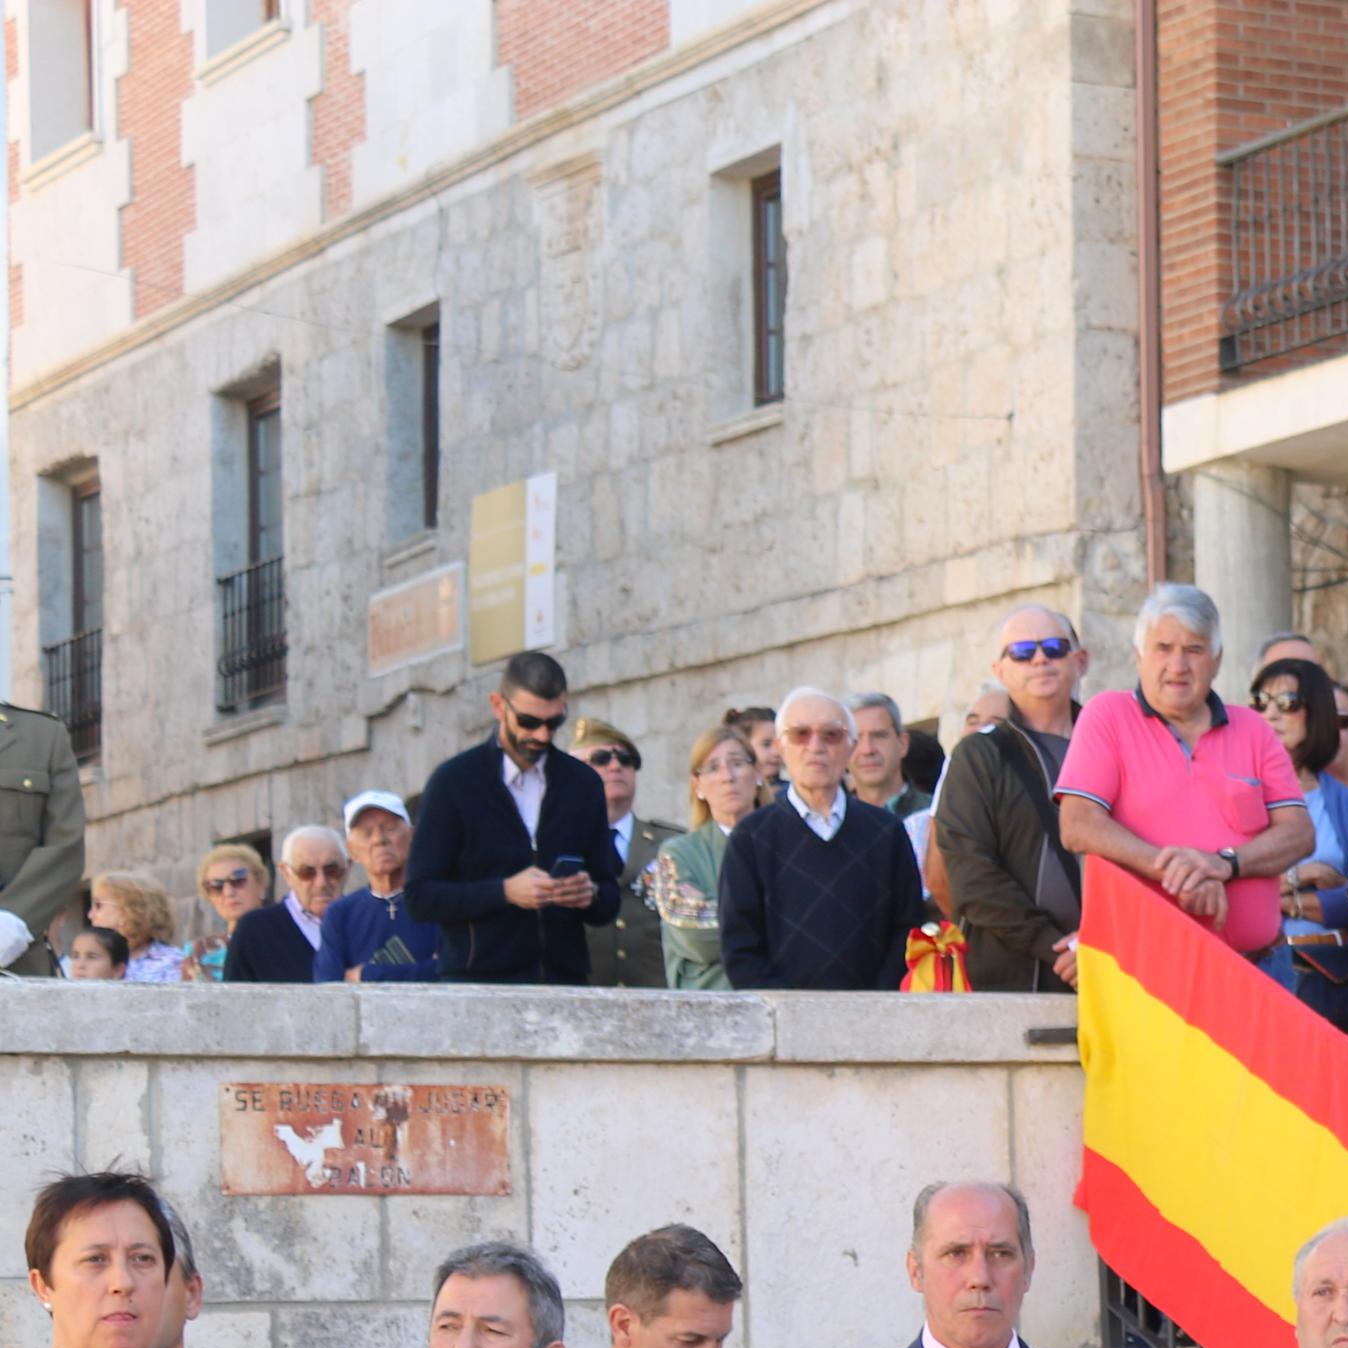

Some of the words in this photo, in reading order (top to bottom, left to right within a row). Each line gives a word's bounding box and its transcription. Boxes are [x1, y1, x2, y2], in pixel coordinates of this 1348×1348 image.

[235, 1090, 266, 1112] SE
[279, 1090, 362, 1113] RUEGA
[355, 1128, 384, 1149] AL
